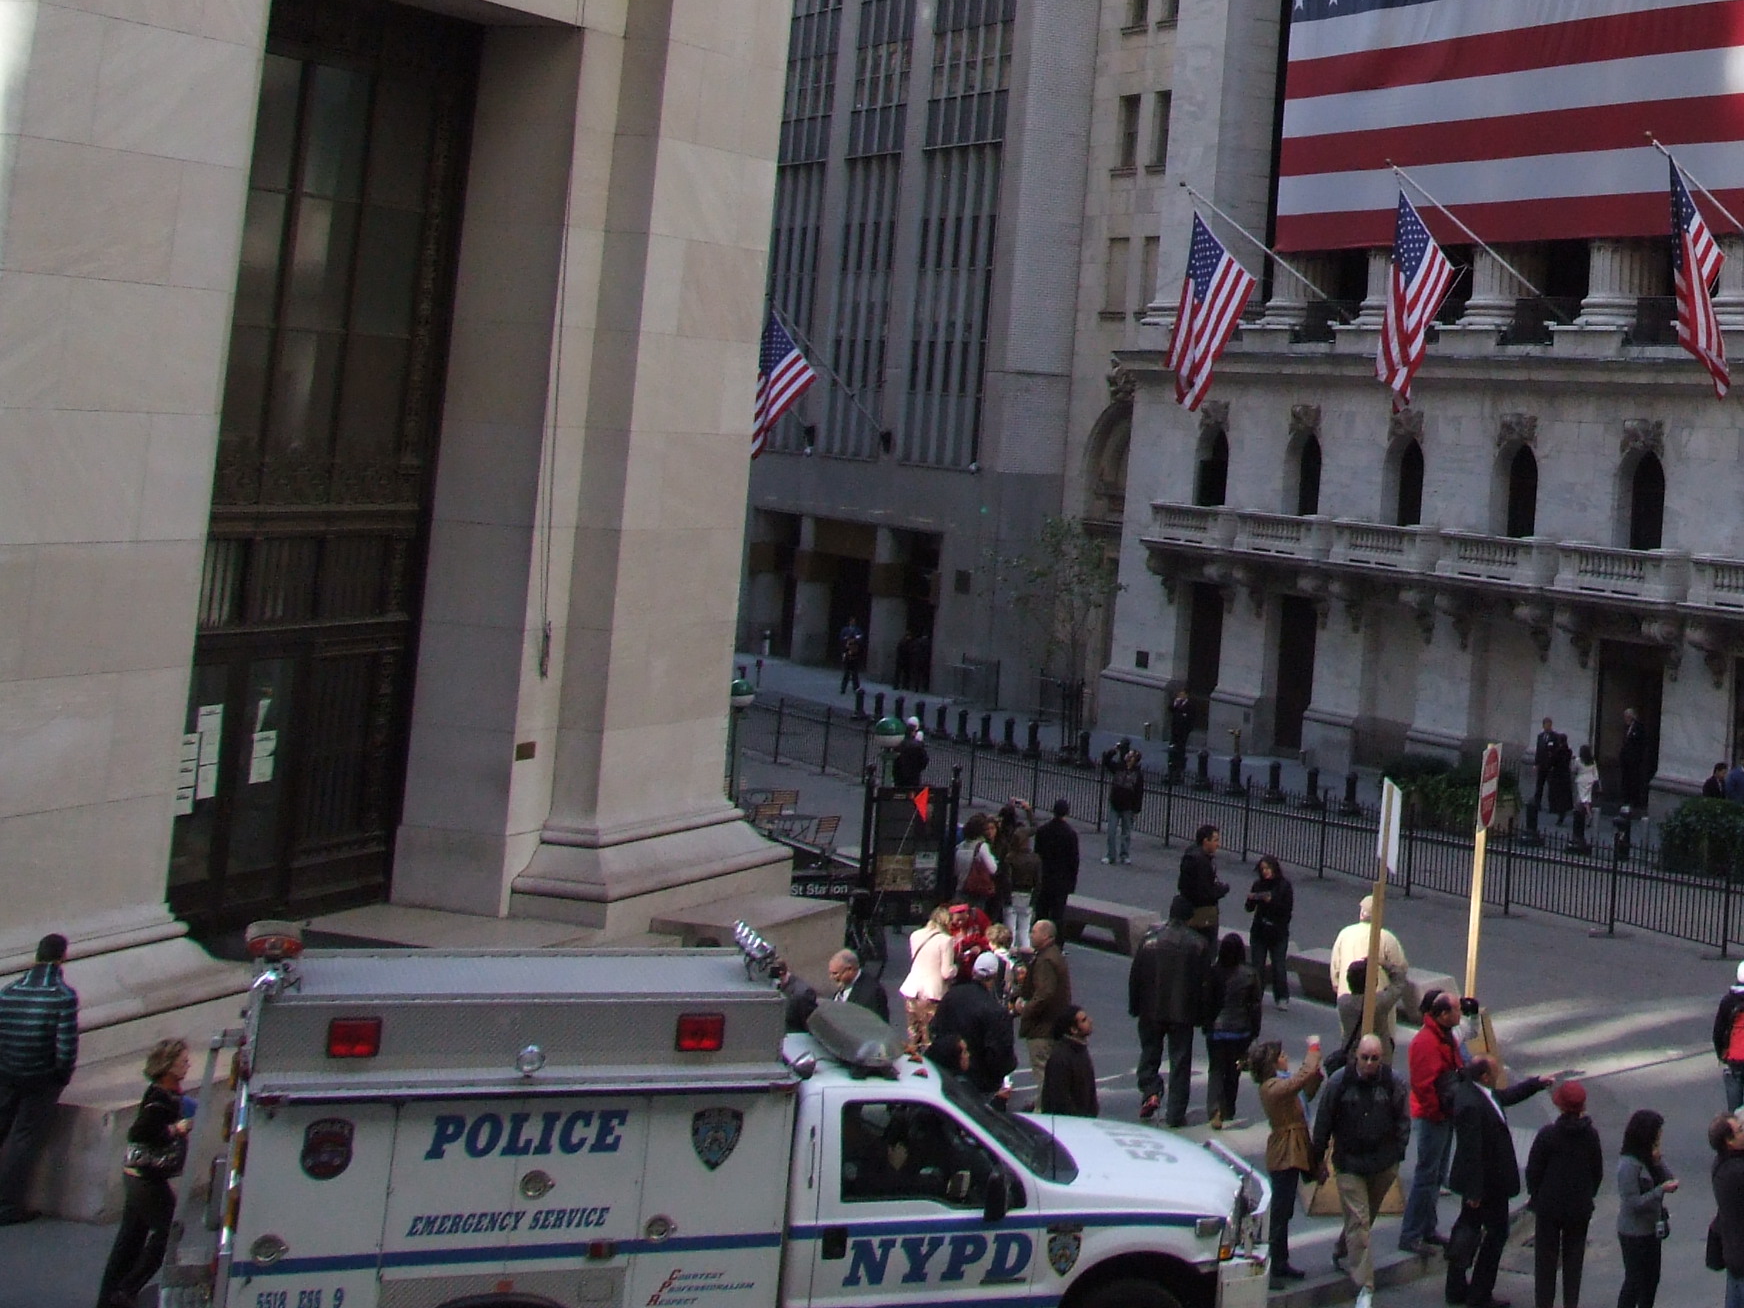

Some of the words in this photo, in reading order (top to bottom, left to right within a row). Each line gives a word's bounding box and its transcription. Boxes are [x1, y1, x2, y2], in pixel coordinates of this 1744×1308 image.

[791, 883, 803, 896] St
[424, 1109, 629, 1160] POLICE
[405, 1211, 527, 1238] EMERGENCY
[528, 1207, 611, 1230] SERVICE
[842, 1232, 1034, 1287] NYPD
